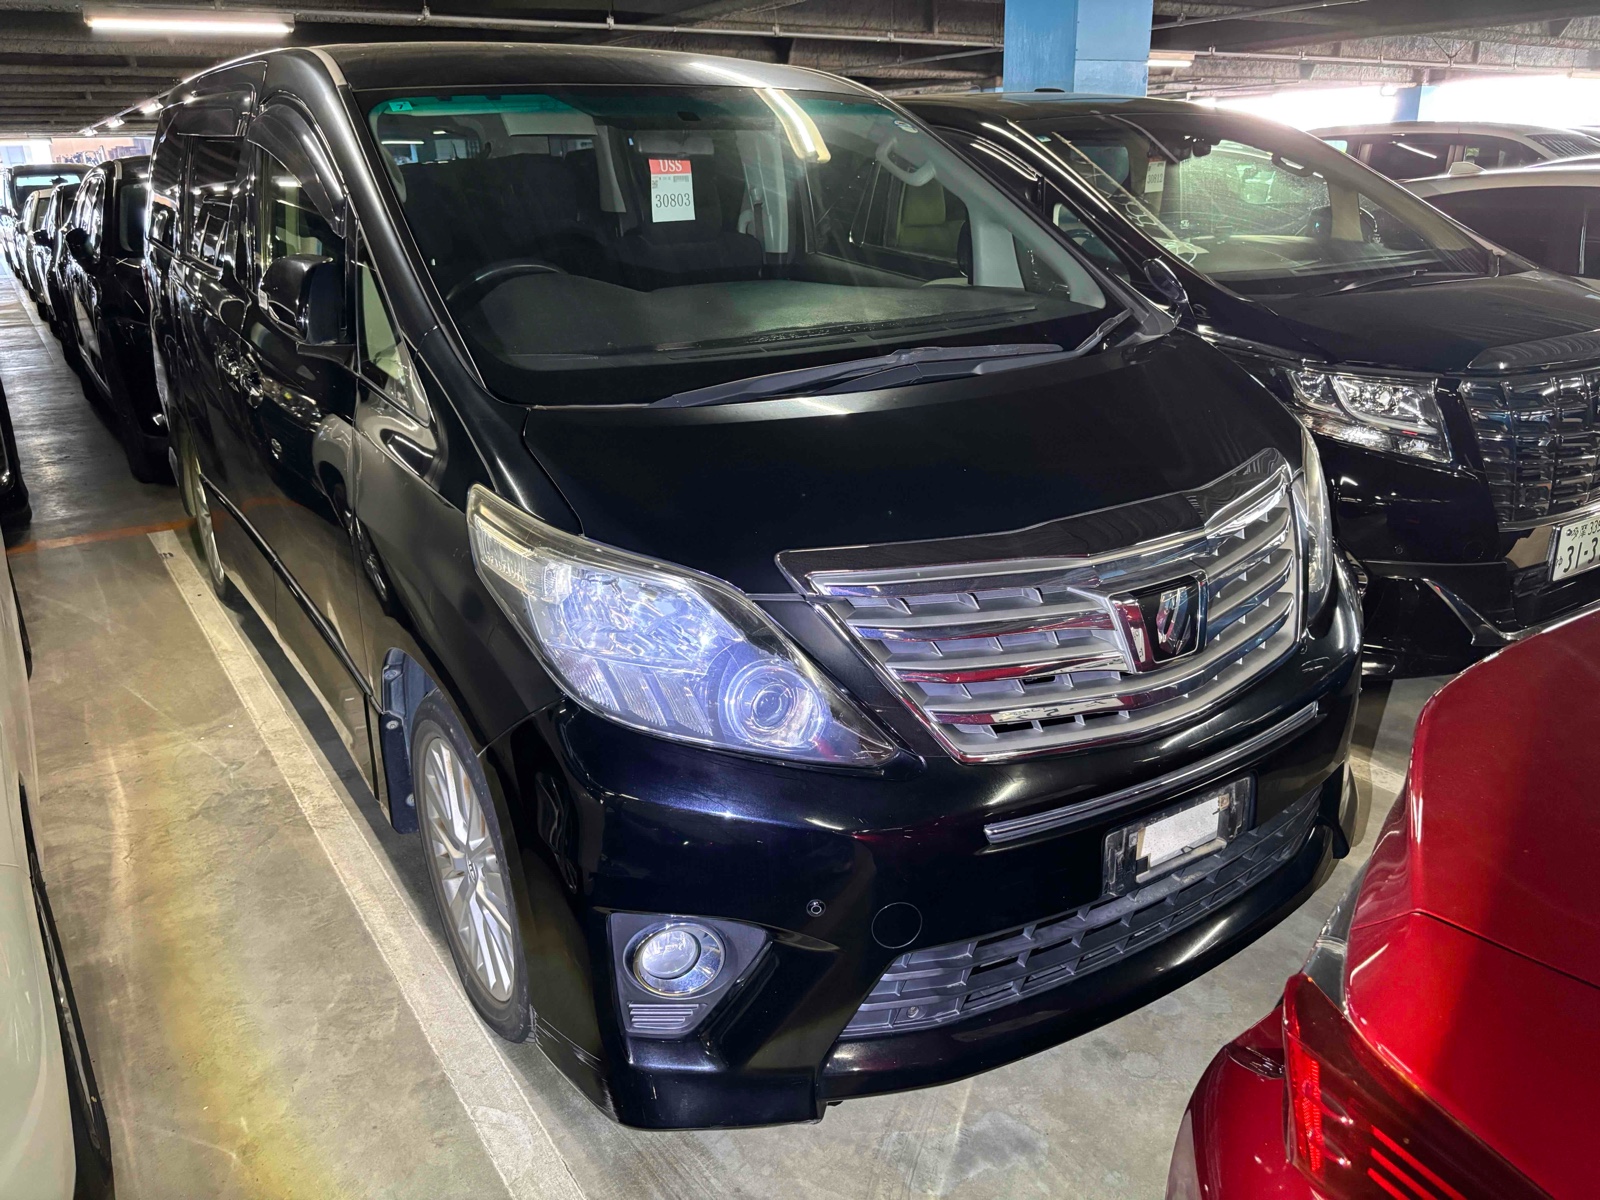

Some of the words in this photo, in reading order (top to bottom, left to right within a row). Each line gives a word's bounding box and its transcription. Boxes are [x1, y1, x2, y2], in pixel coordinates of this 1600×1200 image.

[659, 159, 683, 172] USS
[655, 193, 691, 208] 30803
[1563, 537, 1600, 573] 31-3
